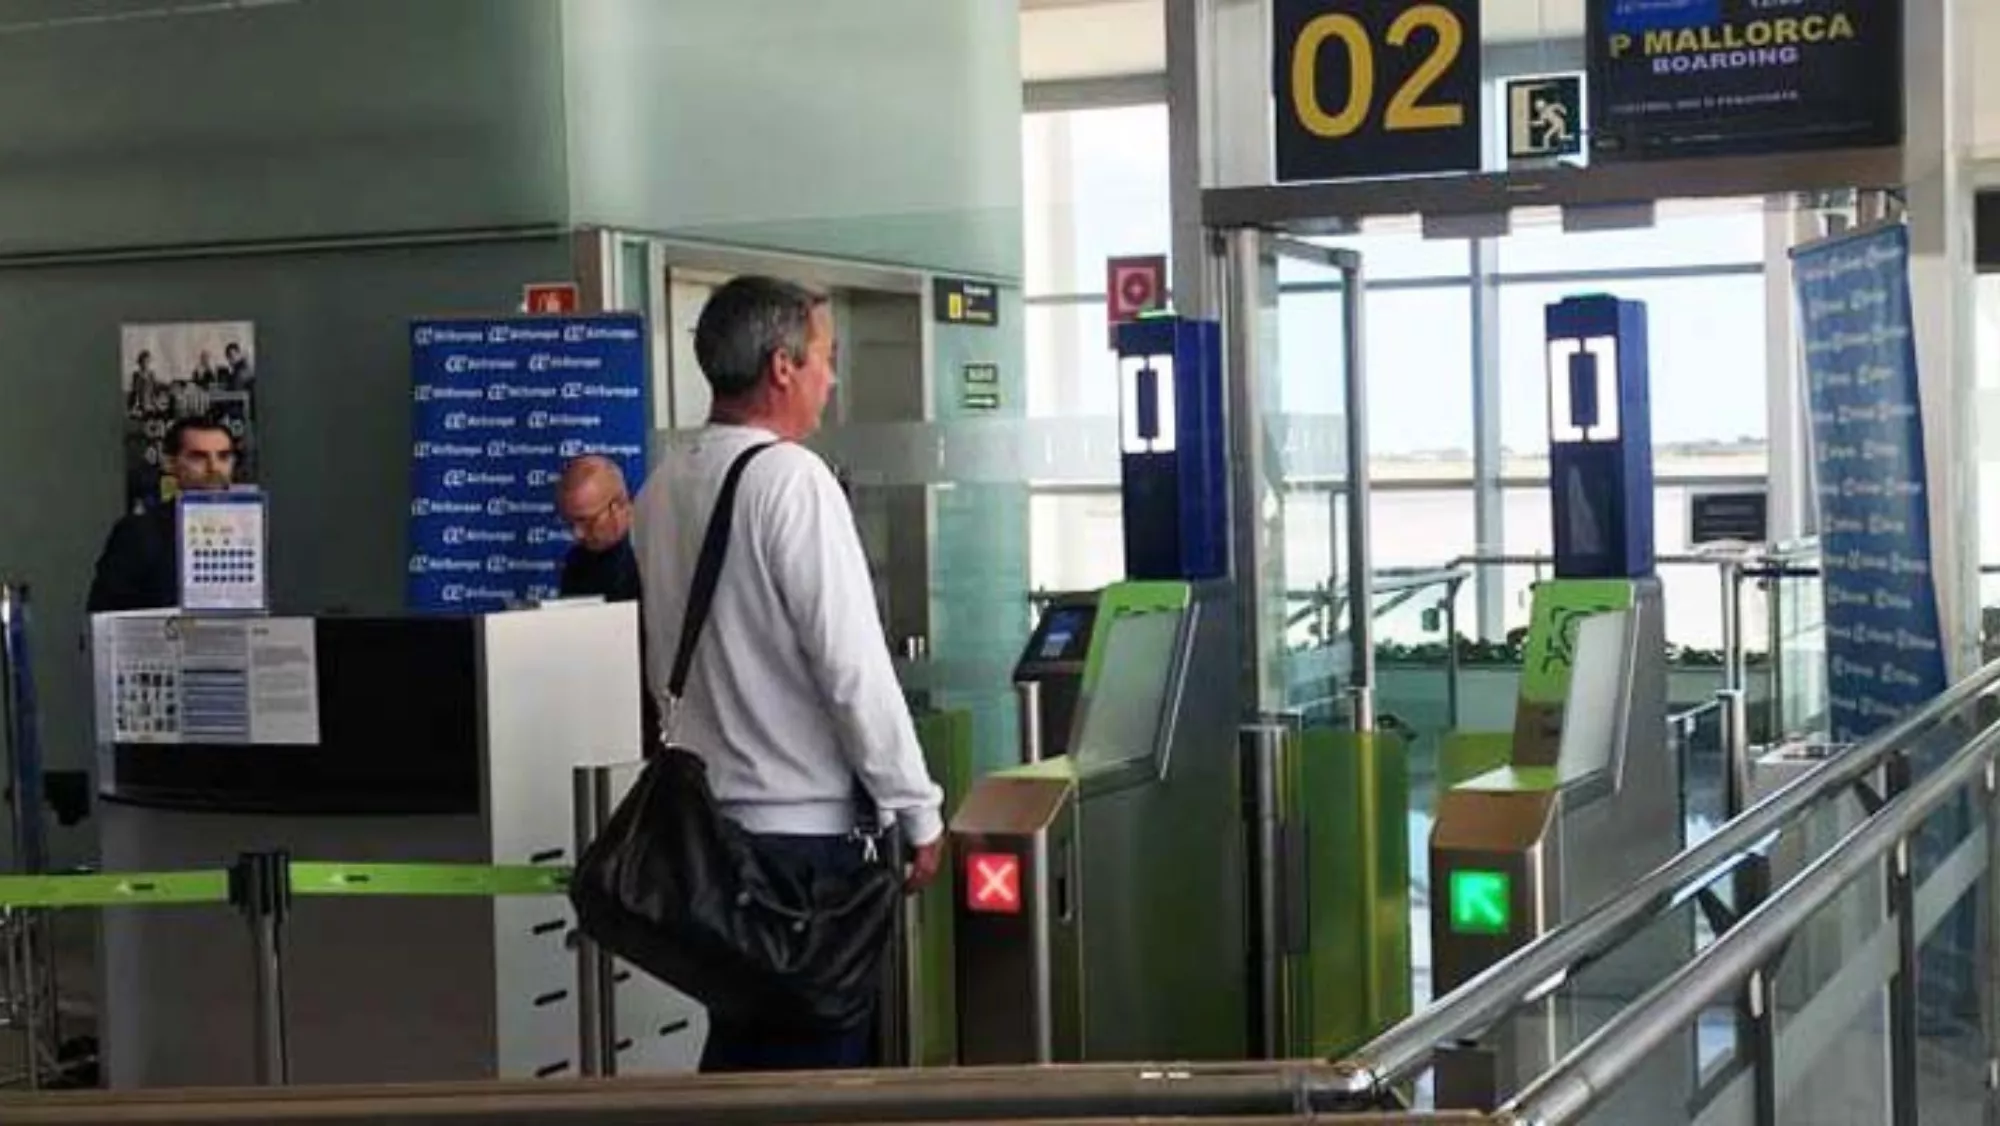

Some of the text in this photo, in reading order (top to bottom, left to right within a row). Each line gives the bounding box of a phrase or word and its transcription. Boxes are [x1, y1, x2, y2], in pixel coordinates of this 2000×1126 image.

[1609, 13, 1854, 58] P MALLORCA
[1291, 3, 1463, 138] 02
[1652, 47, 1799, 73] BOARDING
